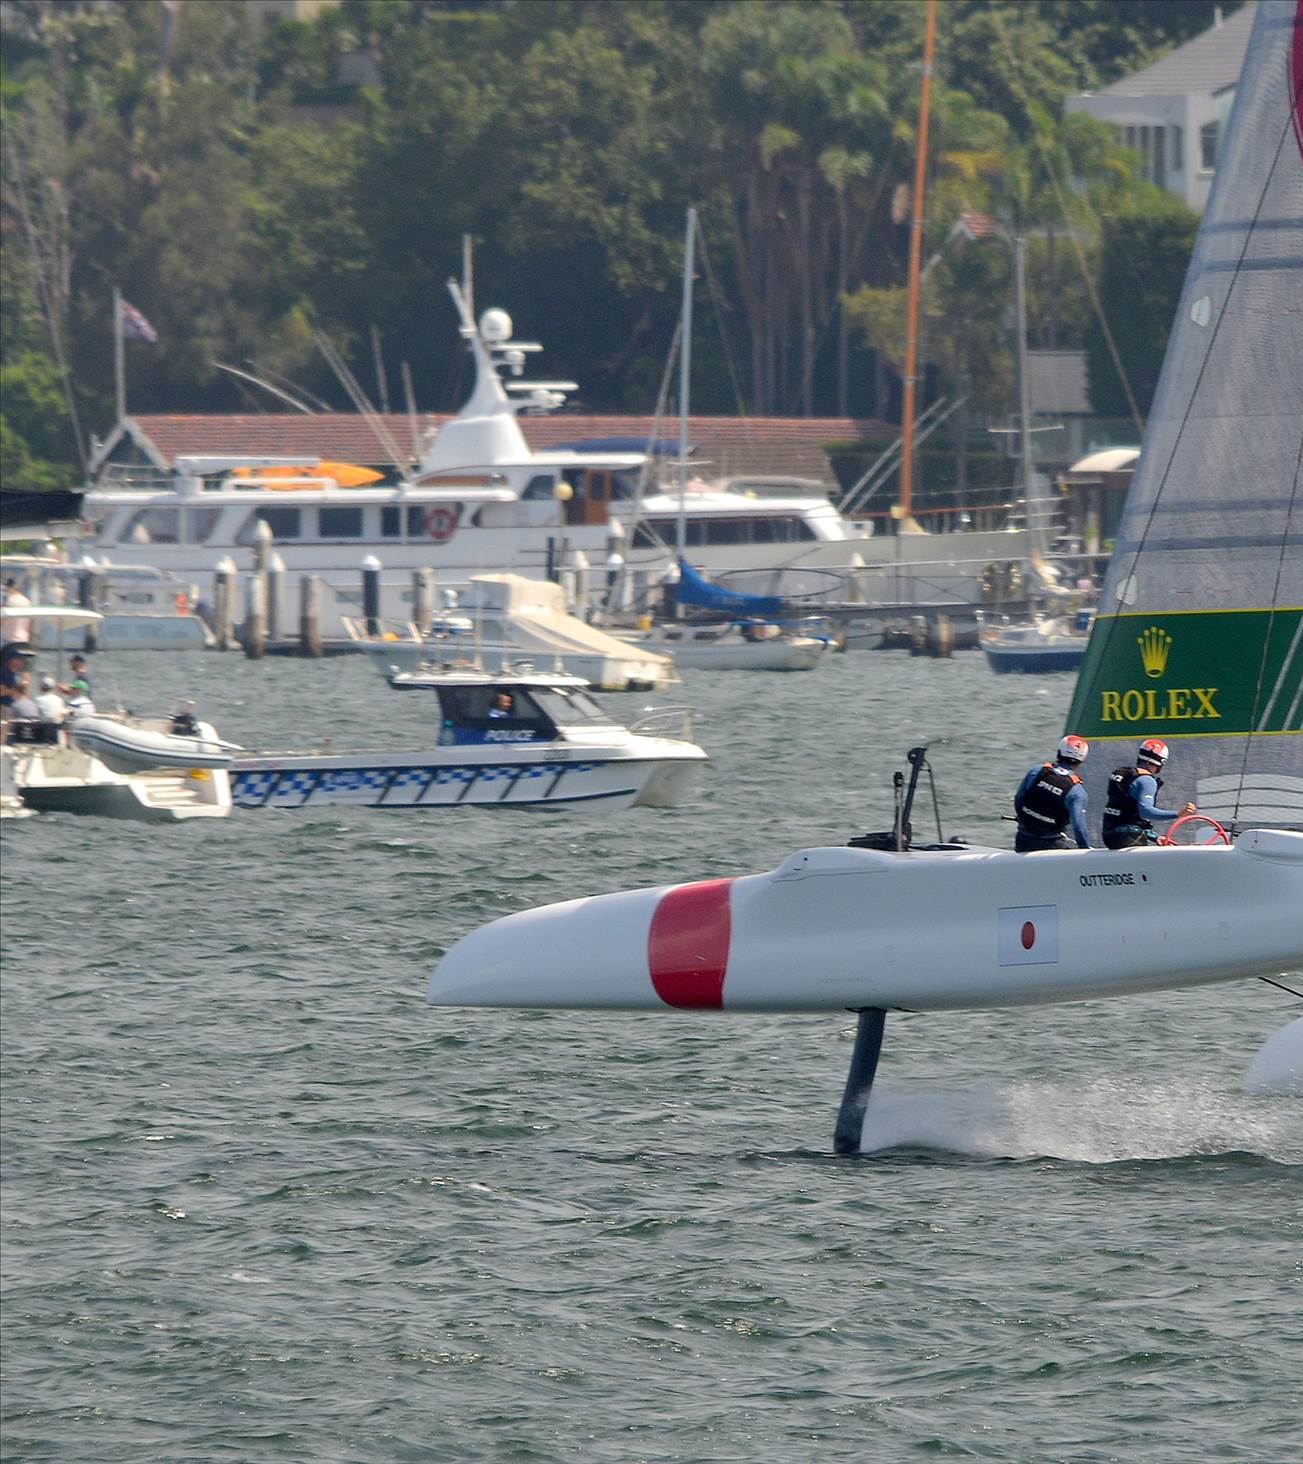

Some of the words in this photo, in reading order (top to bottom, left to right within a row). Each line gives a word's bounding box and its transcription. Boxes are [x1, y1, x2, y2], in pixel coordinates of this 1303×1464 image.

[1101, 687, 1222, 722] ROLEX
[484, 729, 536, 741] POLICE
[1080, 873, 1135, 887] OUTTERIDGE
